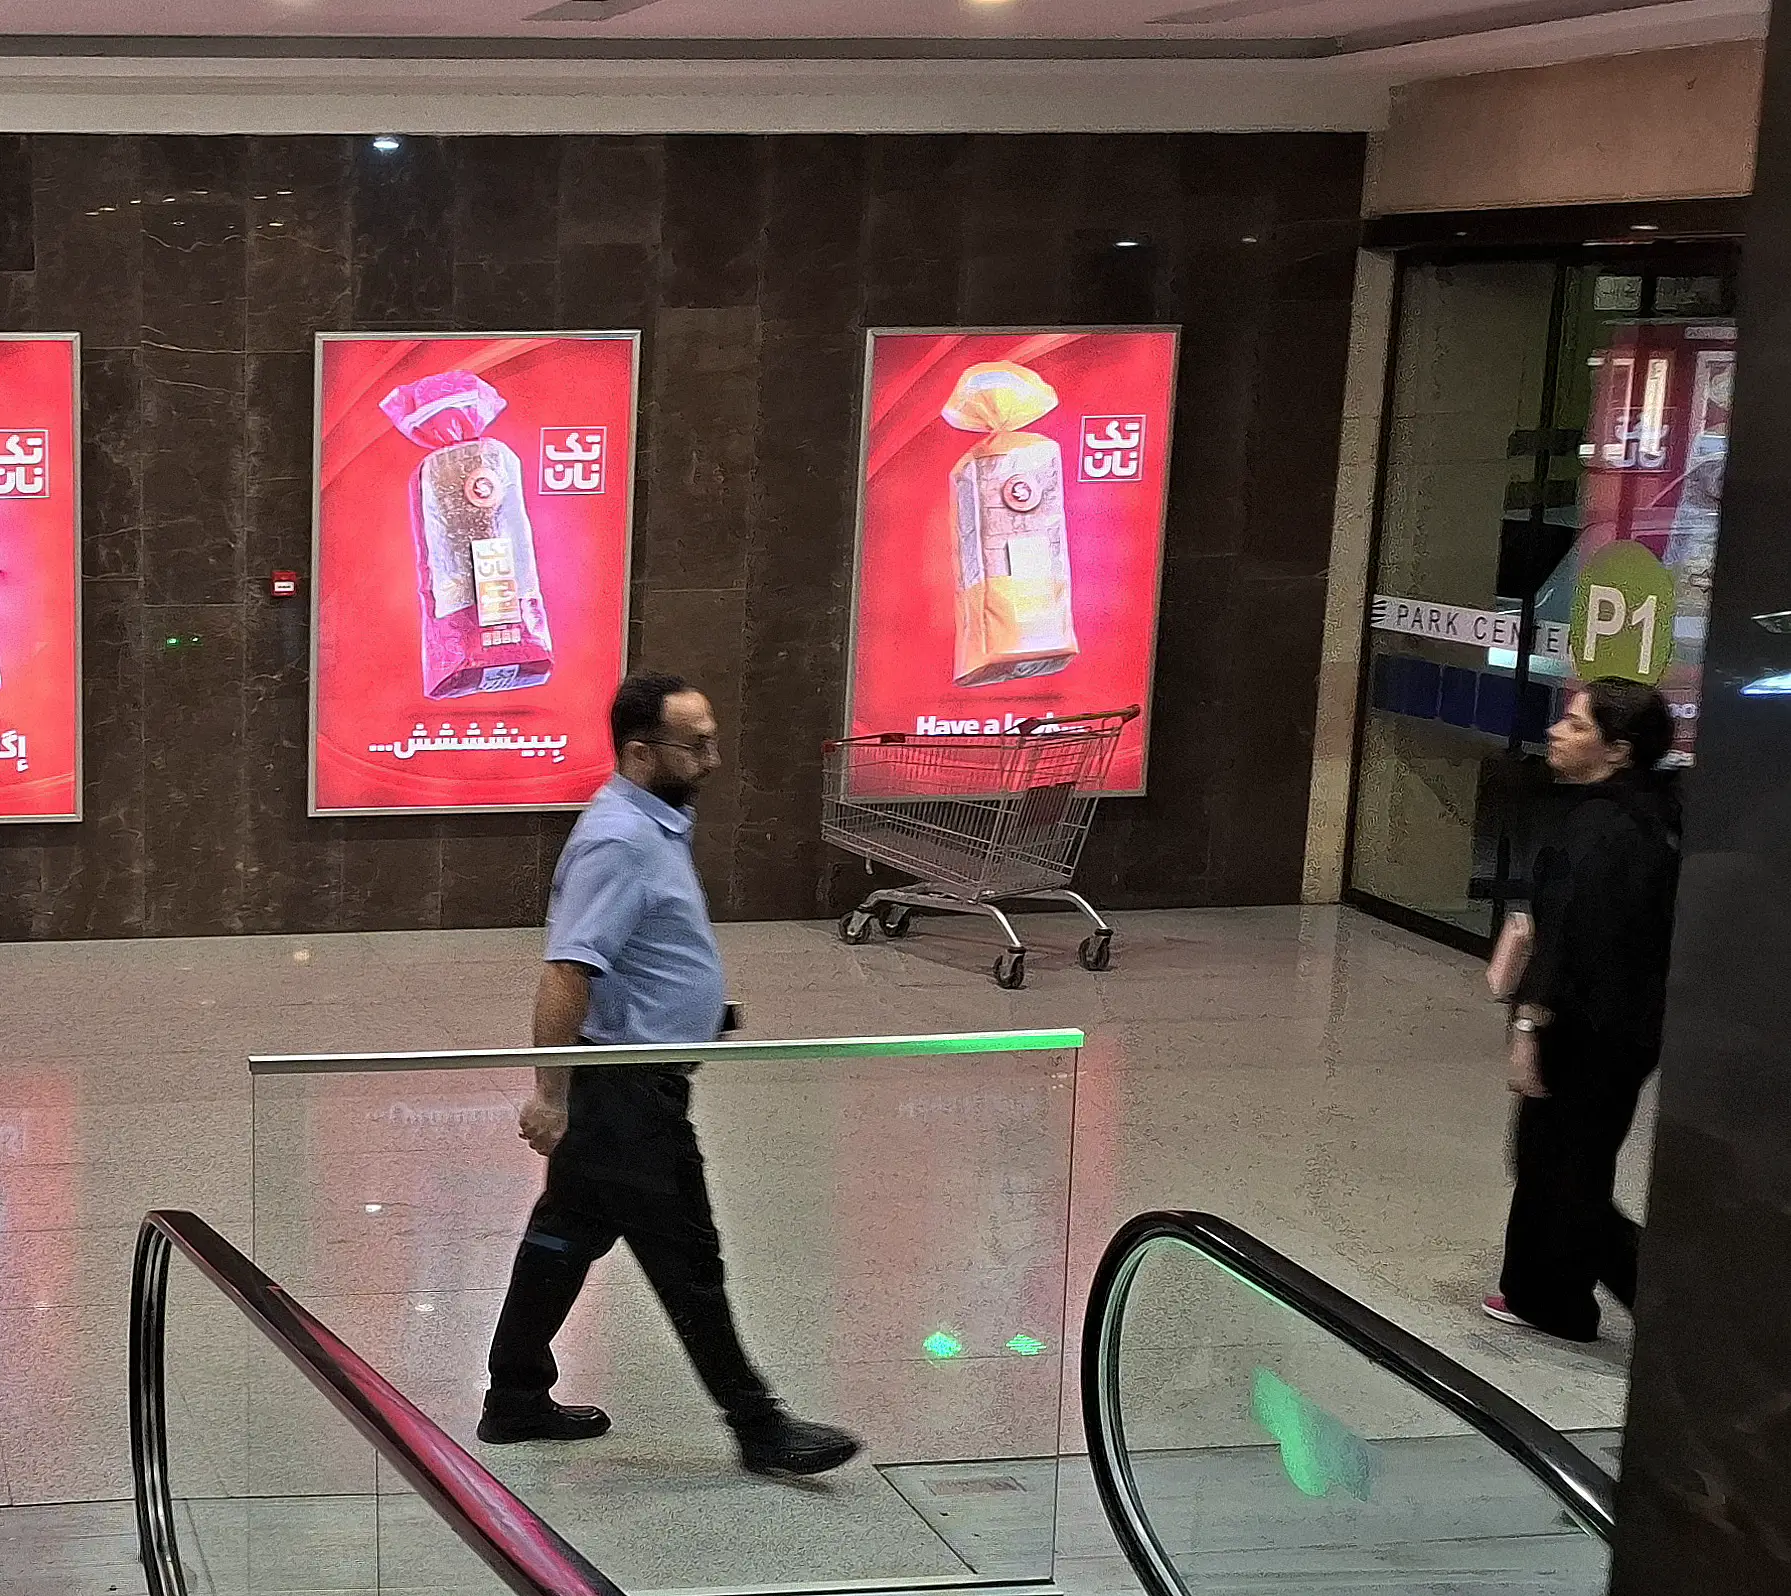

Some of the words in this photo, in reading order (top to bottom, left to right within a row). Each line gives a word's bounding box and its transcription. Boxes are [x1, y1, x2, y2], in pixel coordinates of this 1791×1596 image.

[545, 432, 601, 461] تک
[1085, 420, 1140, 449] تک
[544, 462, 600, 490] نان
[1084, 450, 1138, 478] نان
[1396, 603, 1459, 636] PARK
[1472, 616, 1570, 654] CENE
[1583, 584, 1658, 675] P1
[916, 715, 980, 736] Have
[983, 718, 1000, 736] a
